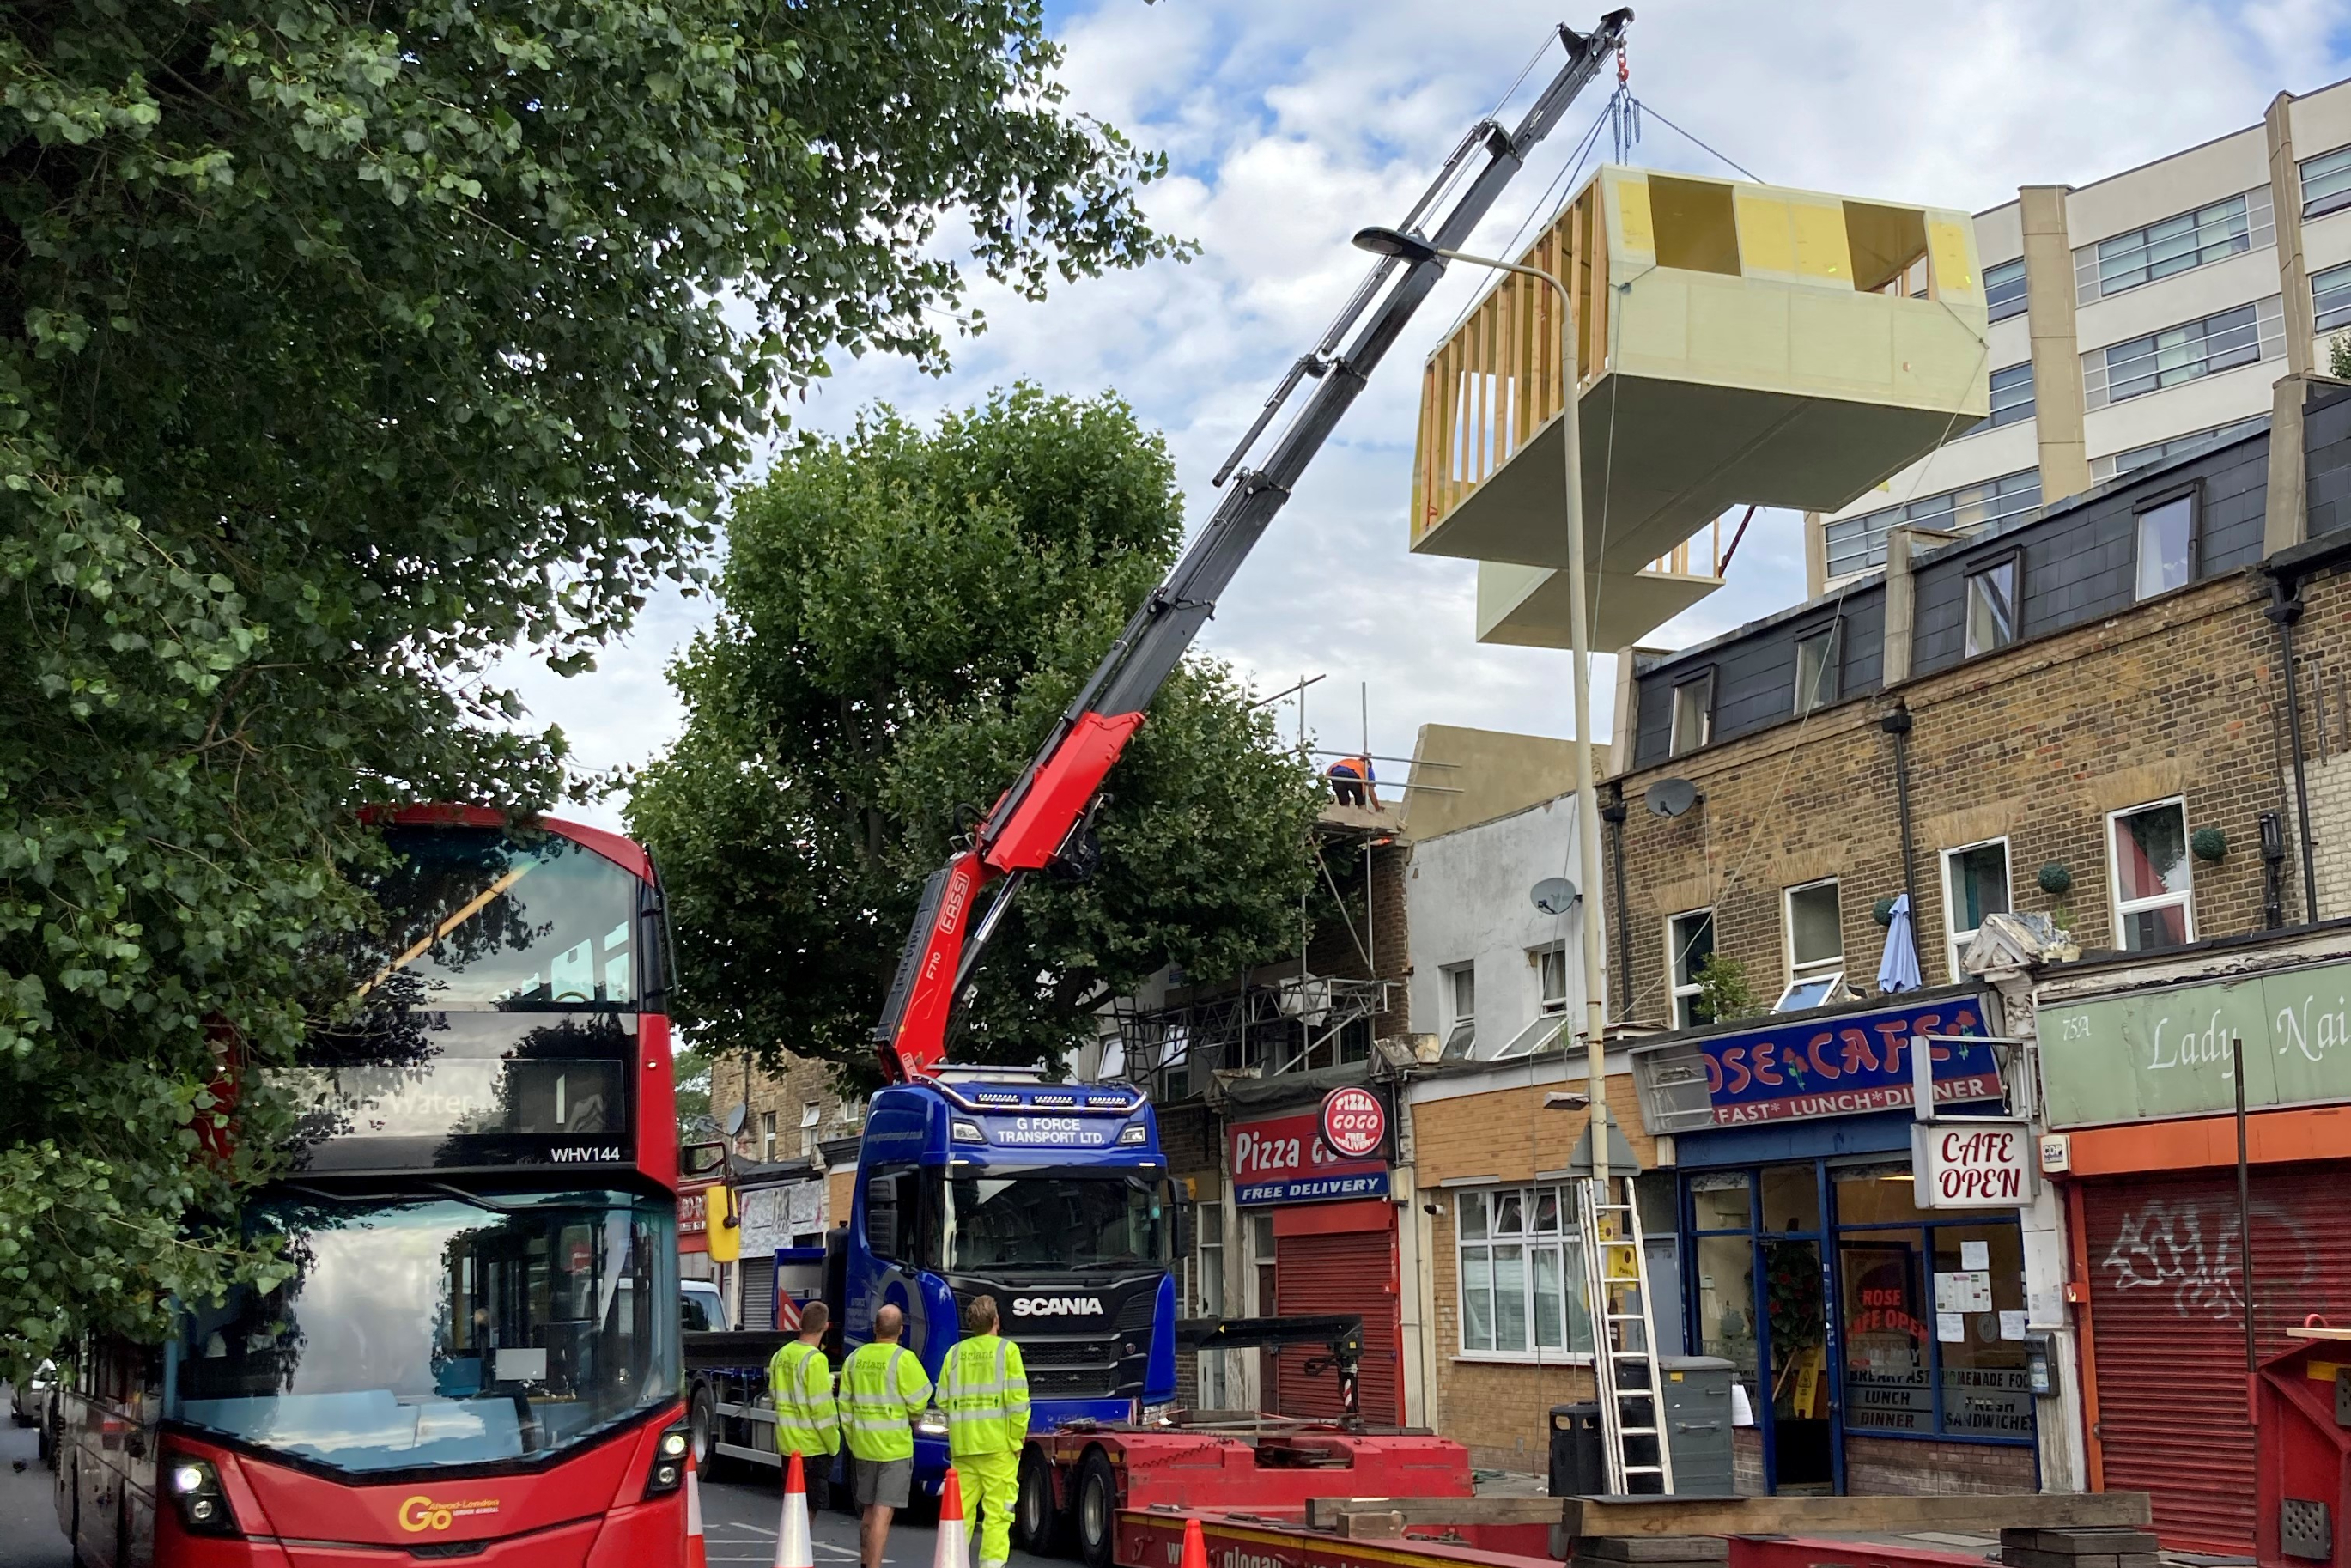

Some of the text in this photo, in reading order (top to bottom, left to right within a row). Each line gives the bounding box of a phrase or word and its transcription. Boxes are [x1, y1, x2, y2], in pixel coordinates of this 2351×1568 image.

[941, 876, 968, 932] FASSI
[926, 951, 941, 981] F710
[2062, 1015, 2093, 1042] 75A
[1807, 1014, 1951, 1079] CAFE
[2147, 1008, 2238, 1079] Lady
[388, 1089, 474, 1115] Water
[556, 1073, 566, 1124] 1
[1335, 1093, 1374, 1112] PIZZA
[1333, 1115, 1379, 1130] GOGO
[1713, 1101, 1781, 1124] FAST
[1017, 1118, 1081, 1131] G FORCE
[998, 1131, 1105, 1145] TRANSPORT LTD.
[1334, 1136, 1376, 1151] DELIVERY
[550, 1146, 621, 1163] WHV144
[1236, 1131, 1301, 1175] Pizza
[1941, 1133, 2015, 1166] CAFE
[1242, 1177, 1380, 1200] FREE DELIVERY
[1939, 1168, 2021, 1199] OPEN
[1012, 1298, 1103, 1316] SCANIA
[1862, 1289, 1901, 1306] ROSE
[1885, 1309, 1929, 1344] OPEN
[854, 1358, 887, 1370] Briant
[959, 1351, 994, 1362] Briant
[1849, 1369, 1931, 1384] BREAKFAST
[1941, 1370, 2029, 1389] HOMEMADE FOO
[1865, 1390, 1911, 1406] LUNCH
[1861, 1412, 1915, 1428] DINNER
[399, 1495, 452, 1532] Go
